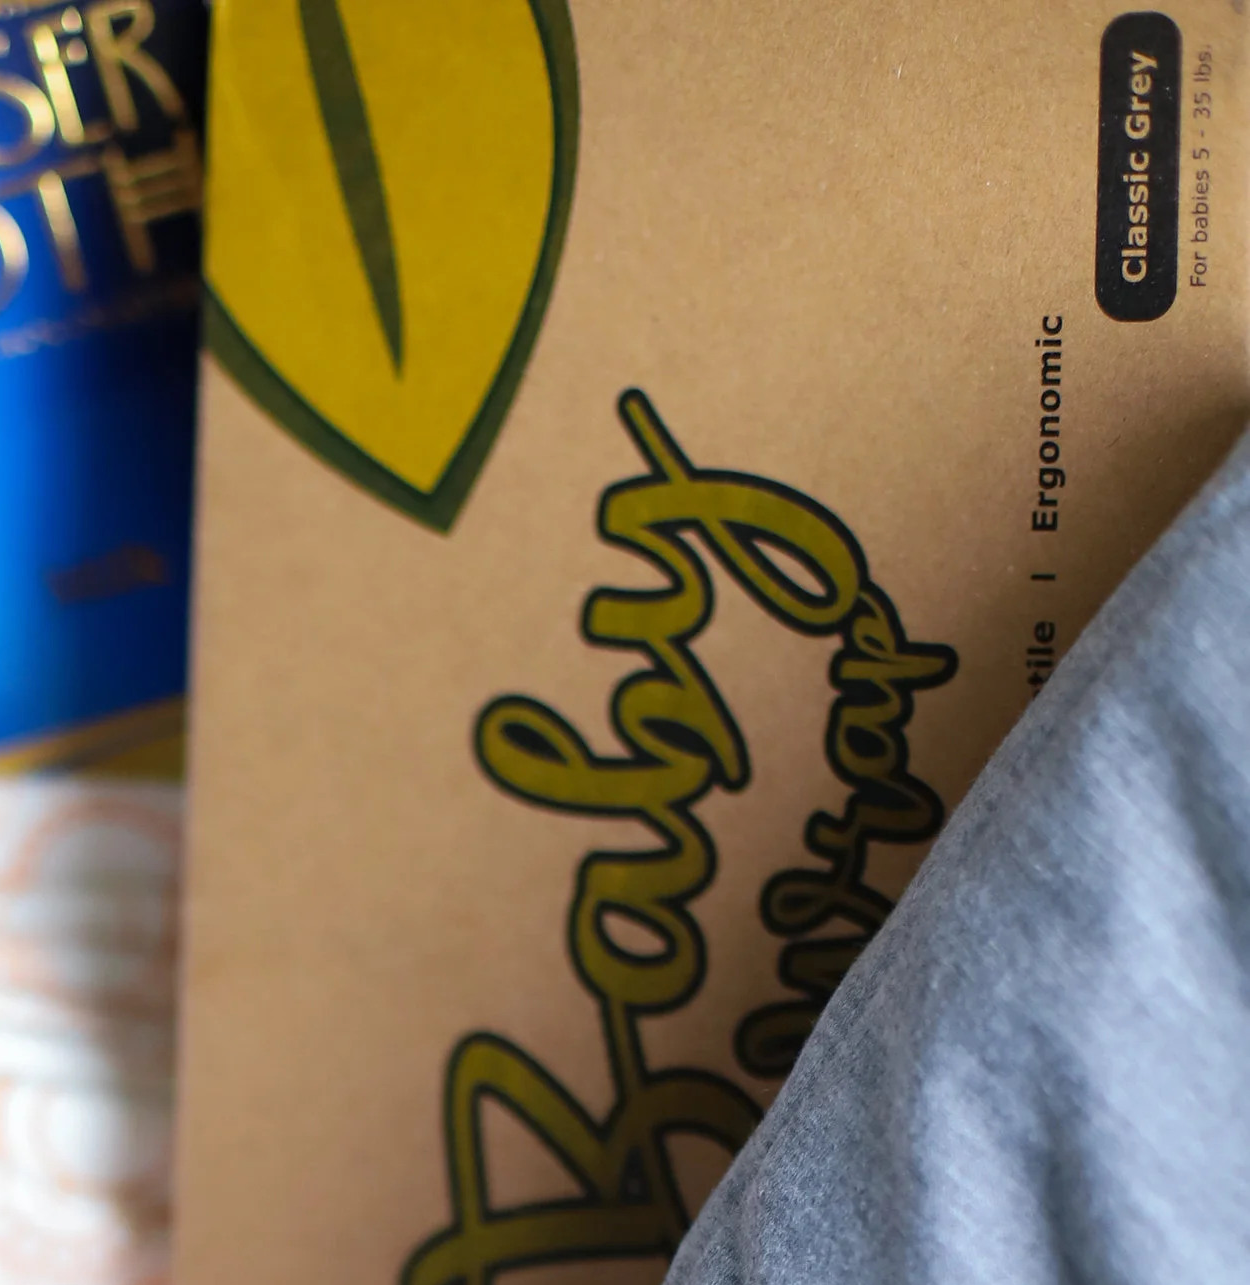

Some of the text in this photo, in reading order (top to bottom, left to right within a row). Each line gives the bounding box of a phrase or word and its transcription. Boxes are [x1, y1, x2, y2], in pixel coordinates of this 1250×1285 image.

[1193, 92, 1212, 119] 35
[1120, 50, 1158, 284] Classic Grey
[1192, 148, 1210, 160] 5
[1190, 170, 1211, 243] babies
[1190, 252, 1208, 287] For
[1032, 315, 1066, 532] Ergonomic
